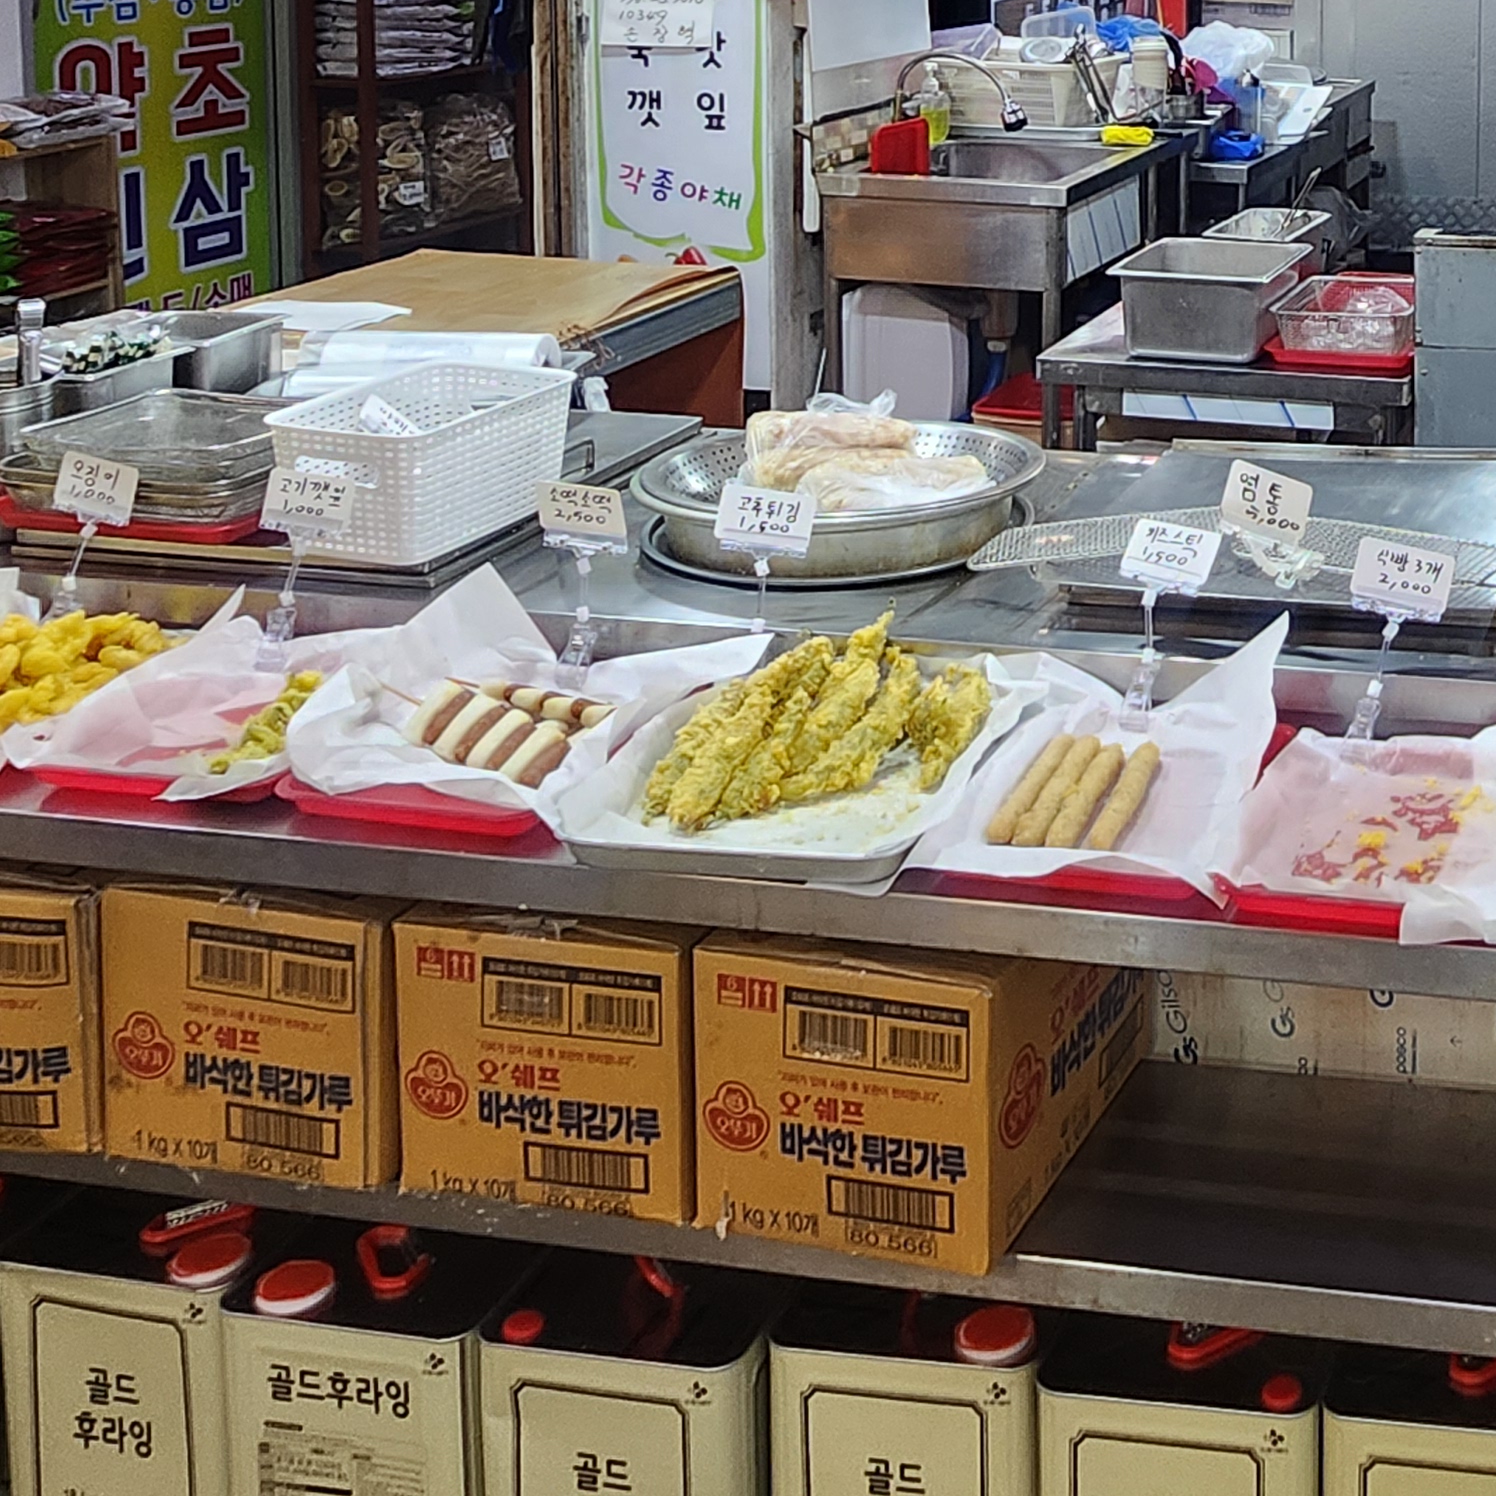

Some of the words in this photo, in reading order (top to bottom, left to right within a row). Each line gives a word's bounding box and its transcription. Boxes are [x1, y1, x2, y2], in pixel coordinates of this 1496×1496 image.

[68, 485, 116, 506] 1,000
[282, 500, 325, 517] 1,000
[554, 508, 607, 525] 2,500
[1141, 547, 1189, 566] 1,500
[1378, 572, 1432, 595] 2,000
[1157, 968, 1188, 1035] Gilsa
[184, 1051, 254, 1098] 바삭한
[257, 1062, 353, 1113] 튀김가루
[477, 1057, 561, 1092] 오'쉐프
[477, 1089, 552, 1134] 바삭한
[556, 1098, 662, 1146] 튀김가루
[778, 1091, 865, 1126] 오'쉐프
[779, 1121, 857, 1169] 바삭한
[861, 1133, 968, 1185] 튀김가루
[85, 1366, 140, 1406] 골드
[267, 1363, 411, 1420] 골드후라잉
[73, 1411, 153, 1459] 후라잉
[572, 1451, 633, 1496] 골드
[864, 1456, 926, 1496] 골드
